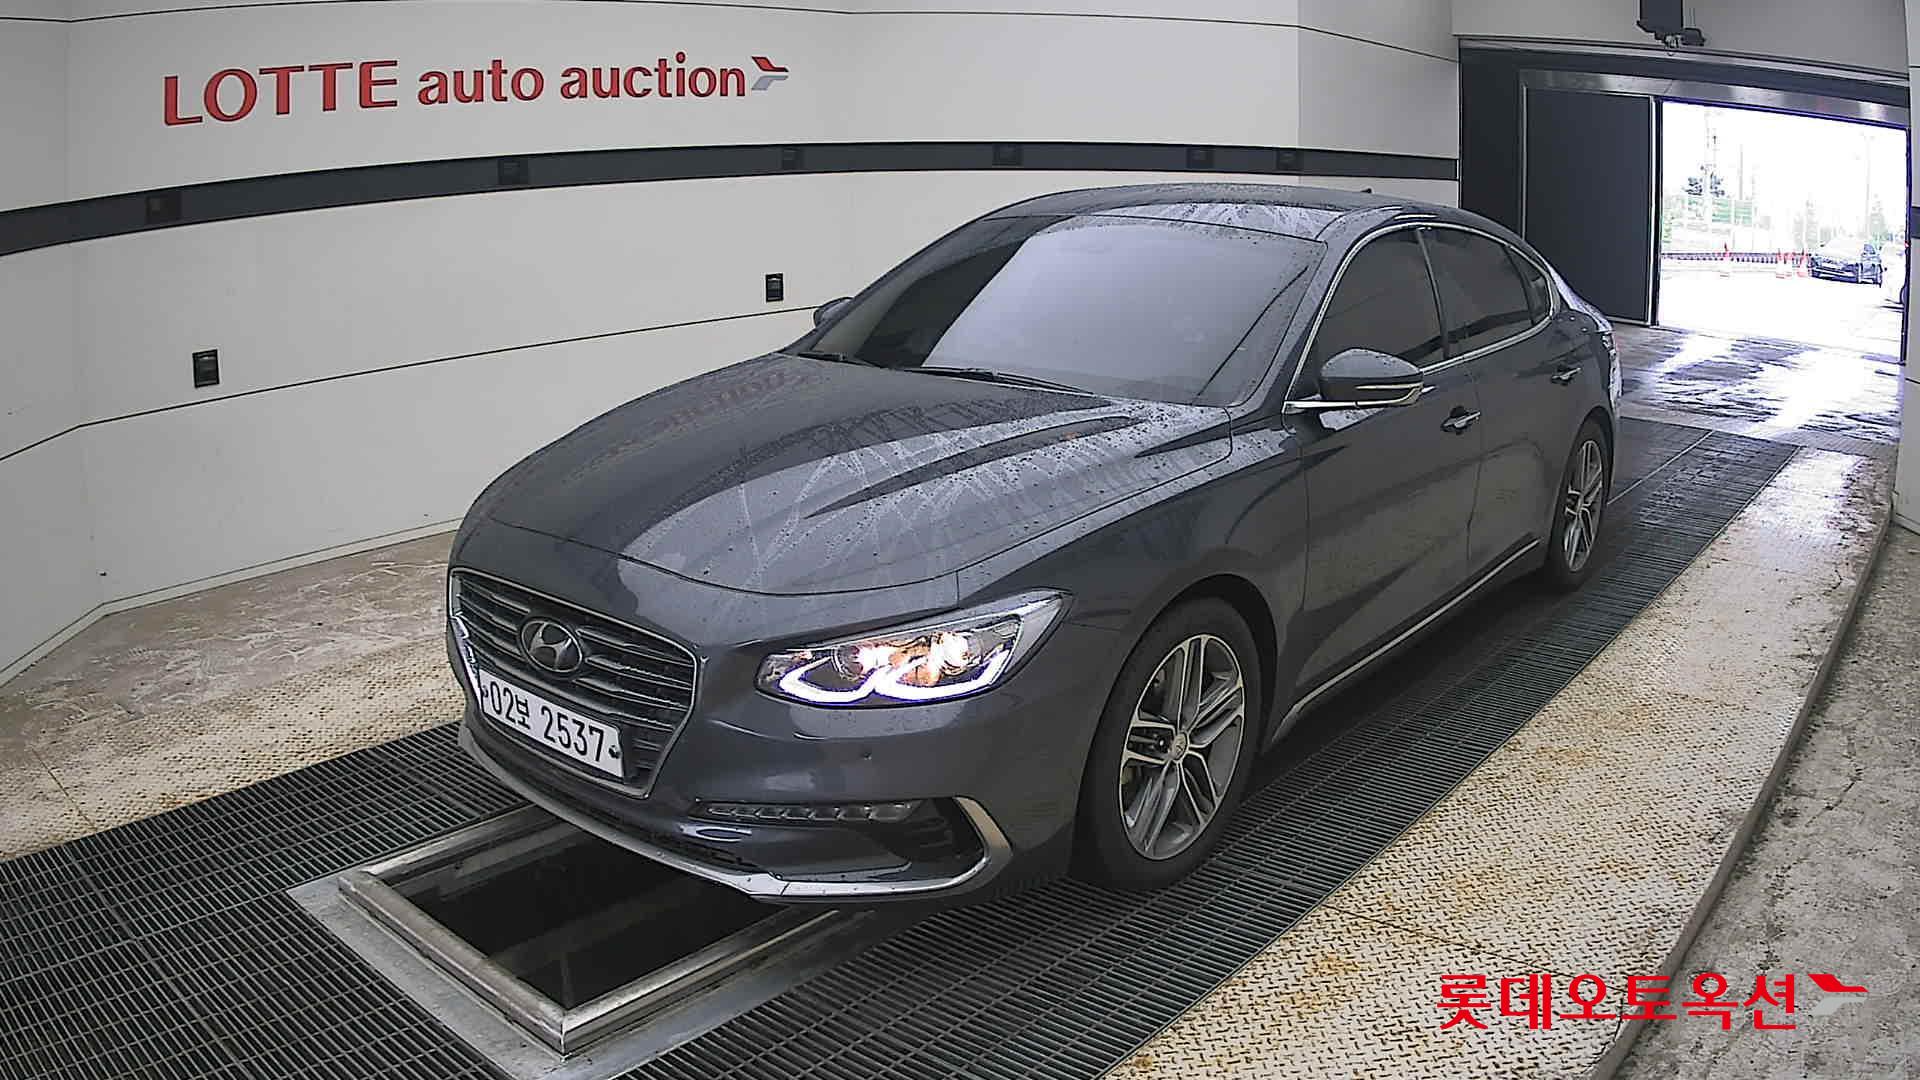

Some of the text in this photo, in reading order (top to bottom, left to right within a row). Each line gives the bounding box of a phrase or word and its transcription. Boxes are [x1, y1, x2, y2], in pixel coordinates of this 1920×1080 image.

[163, 51, 747, 126] LOTTE auto auction
[489, 680, 605, 763] 02보 2537
